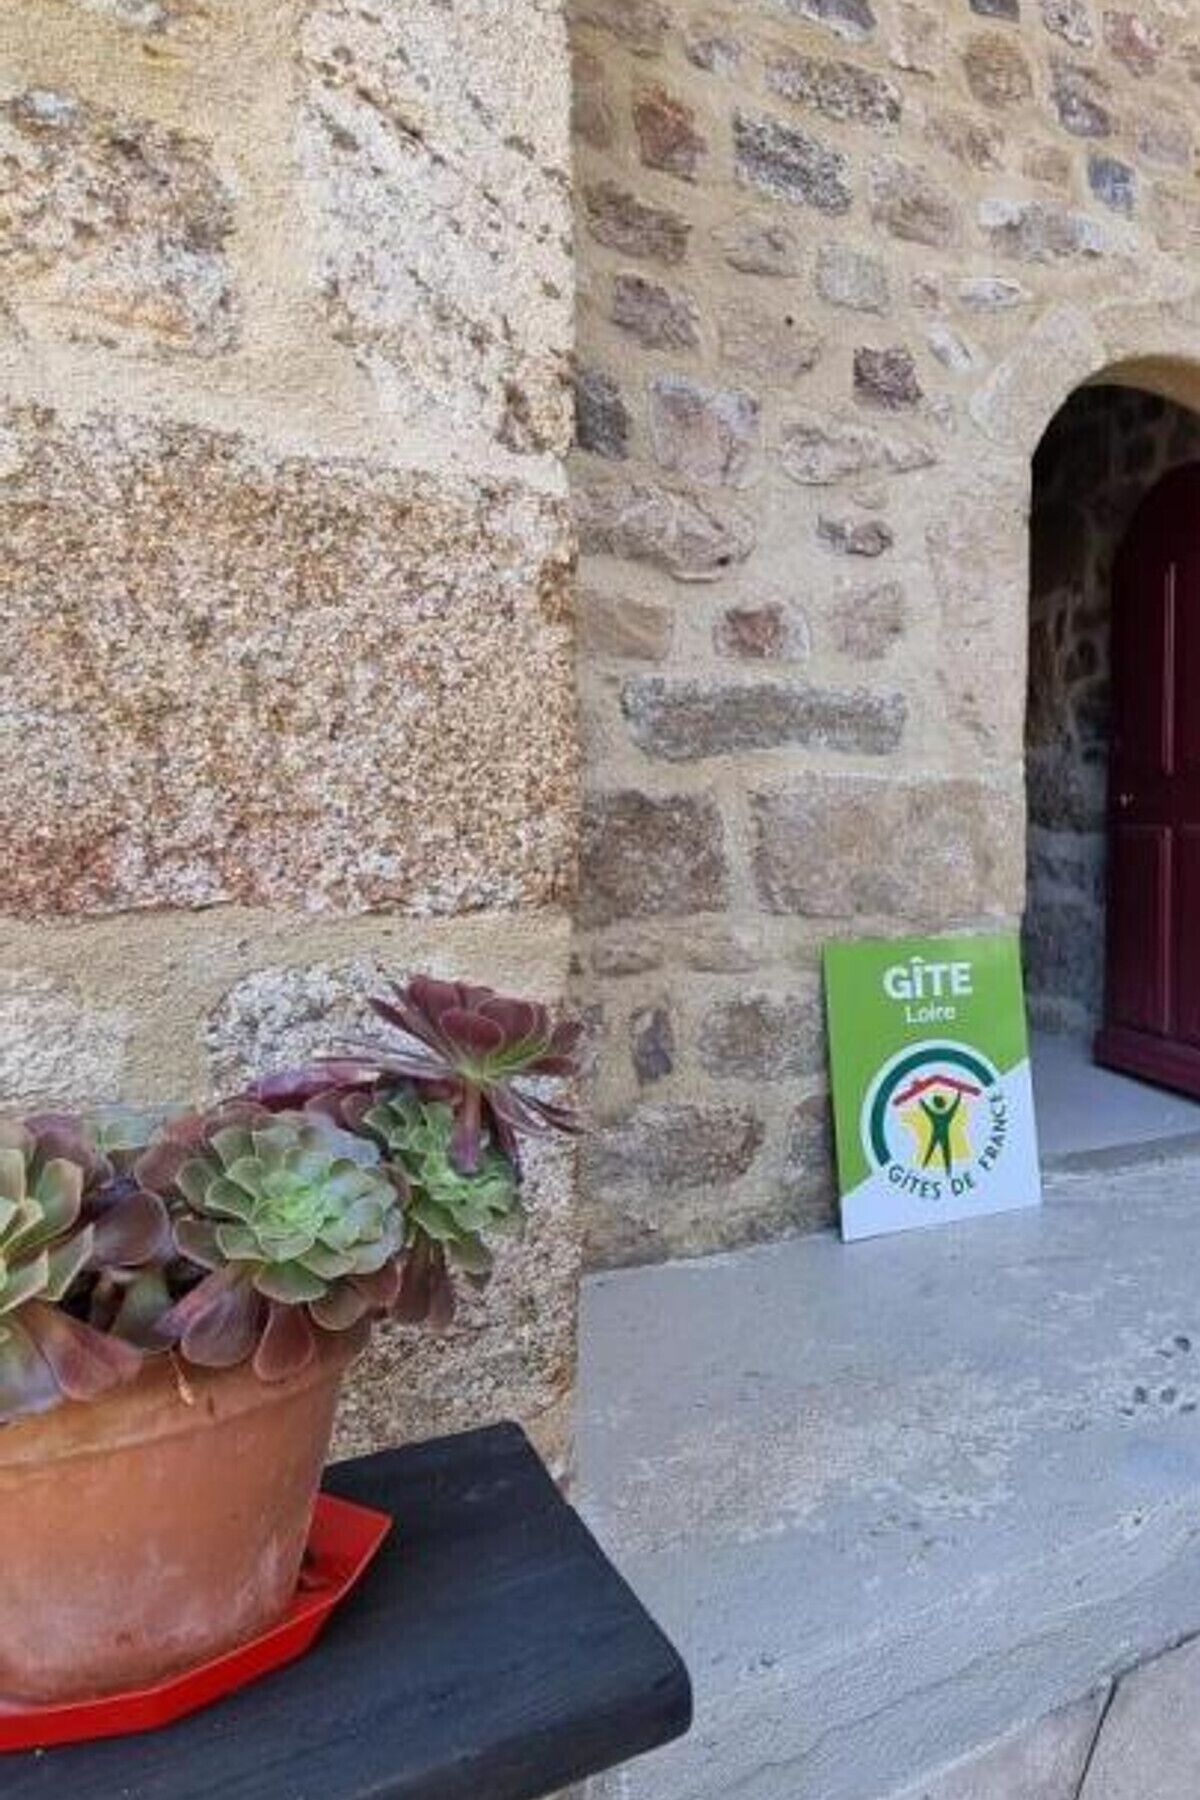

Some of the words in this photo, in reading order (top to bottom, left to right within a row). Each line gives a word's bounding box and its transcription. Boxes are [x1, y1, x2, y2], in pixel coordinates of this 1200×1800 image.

[883, 956, 973, 1000] GÎTE
[905, 1002, 956, 1023] Loire
[951, 1172, 976, 1197] DE
[978, 1093, 1009, 1171] FRANCE
